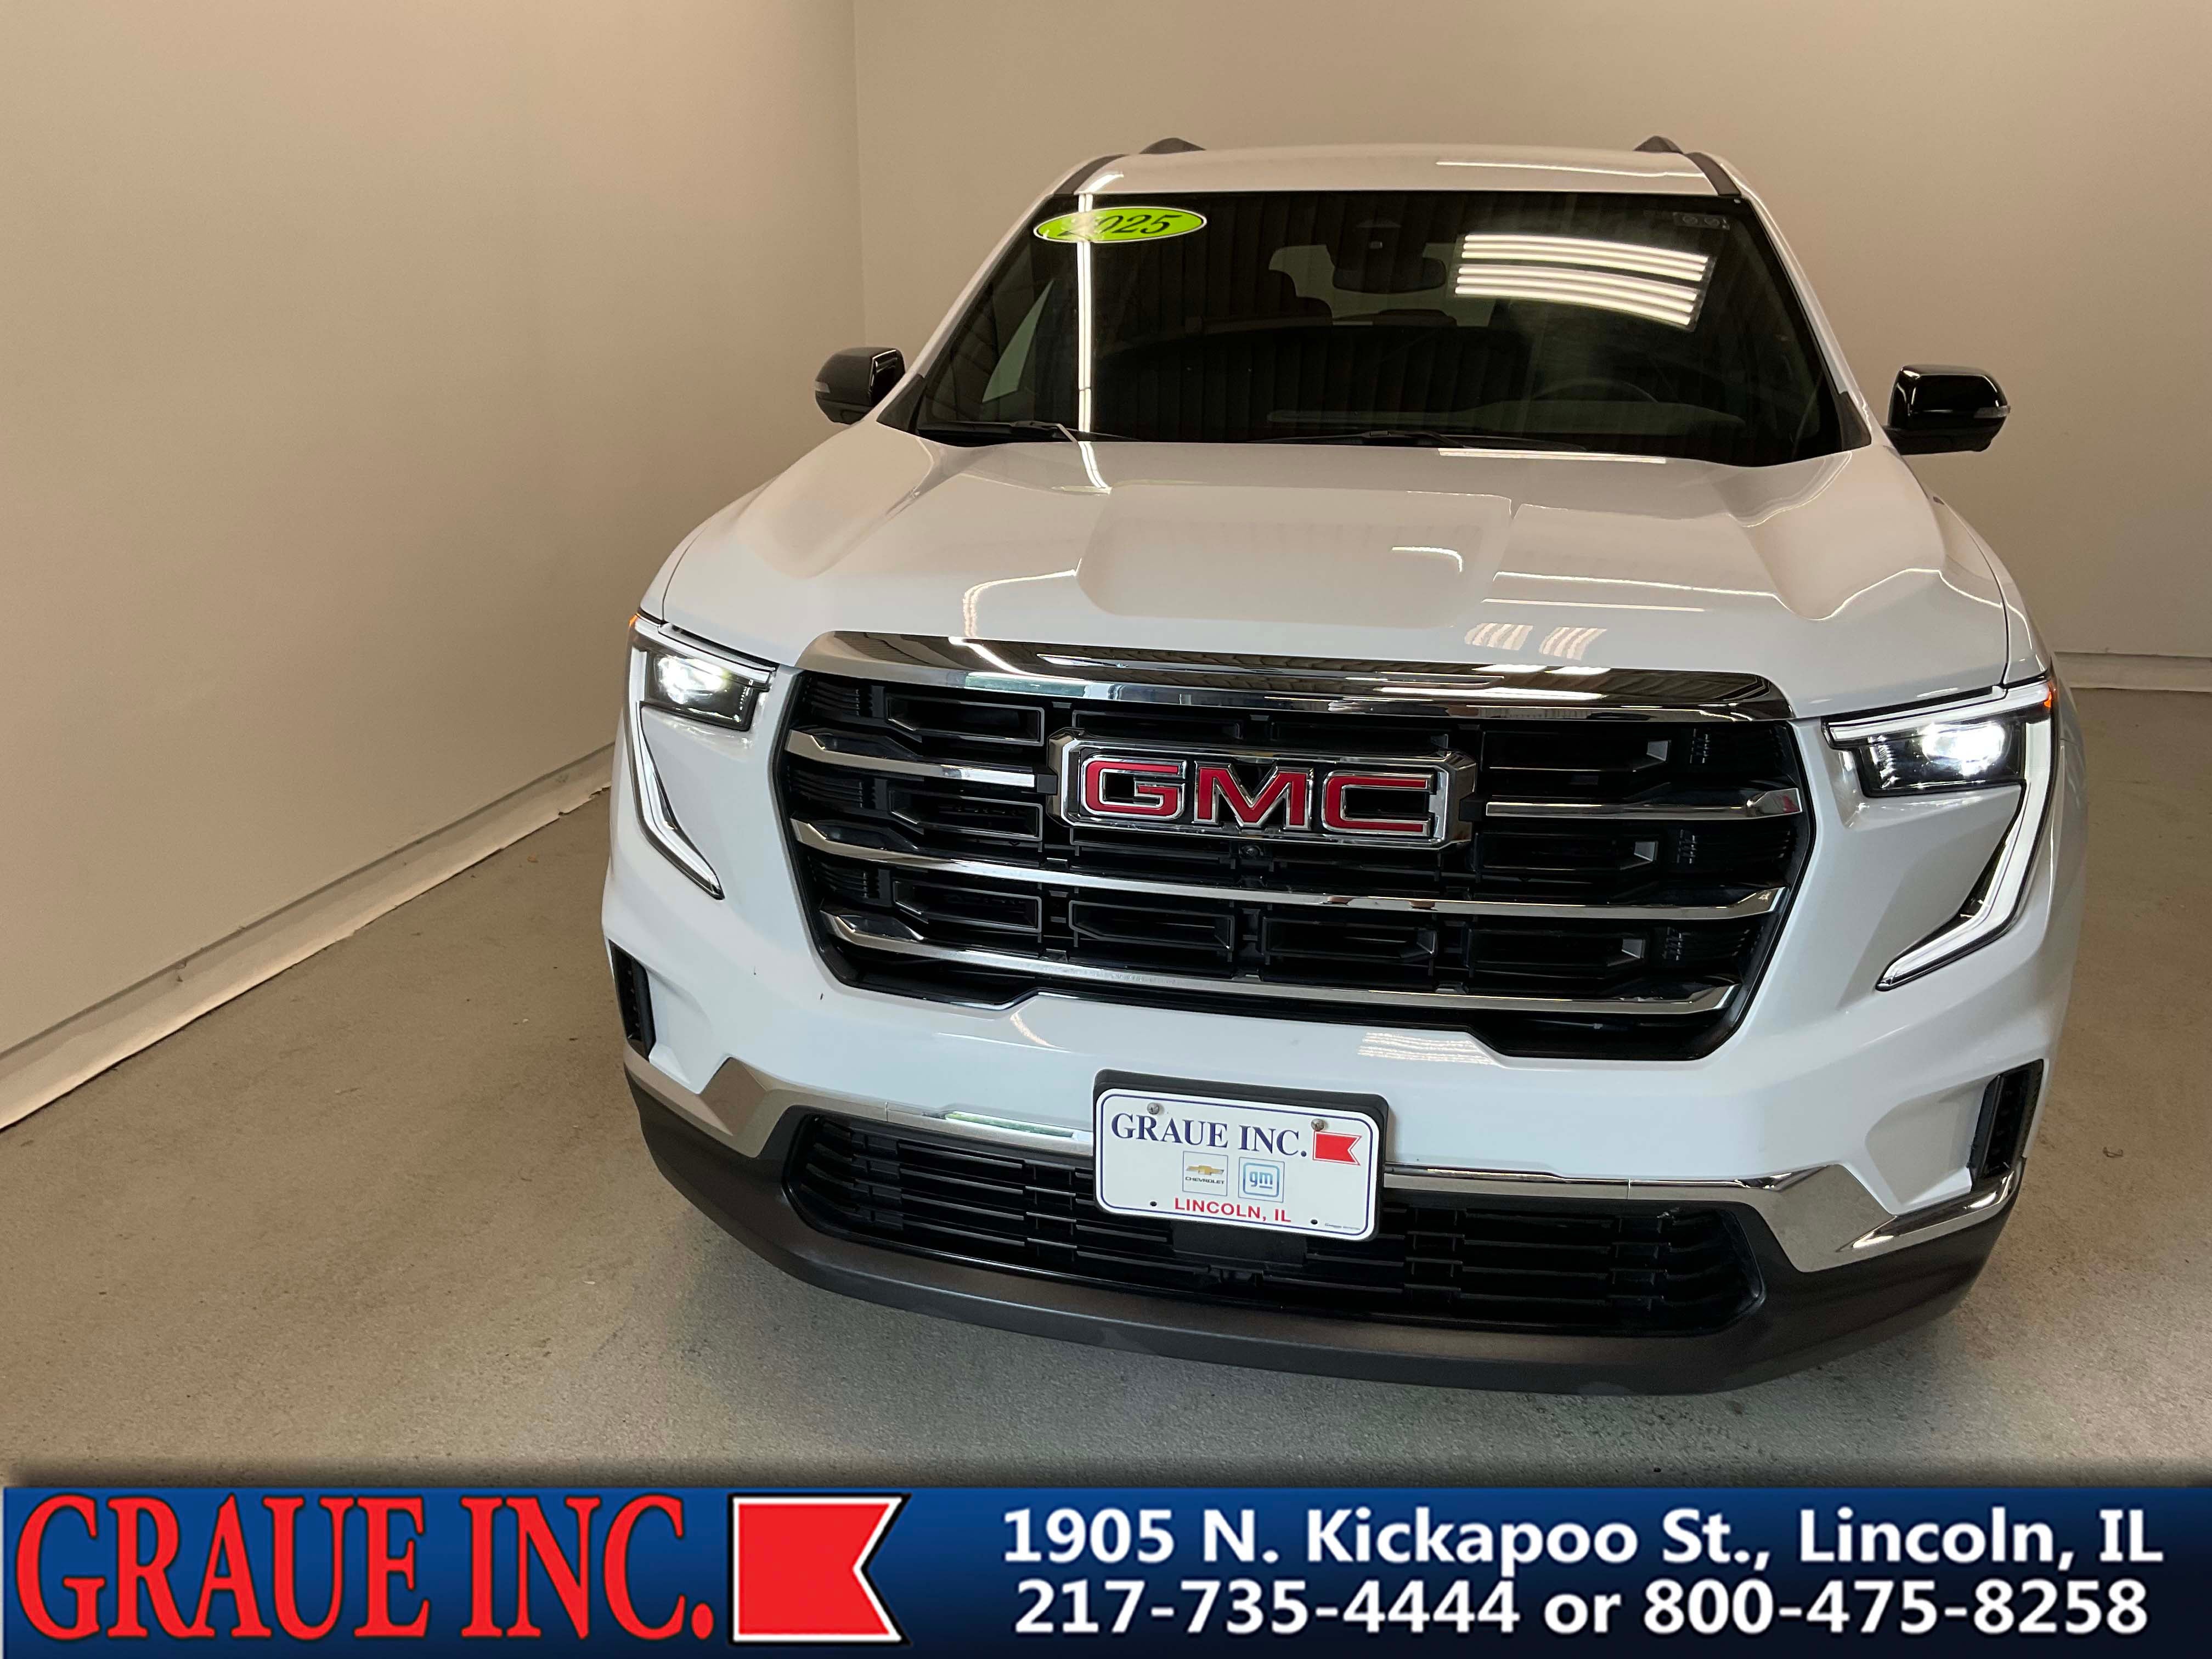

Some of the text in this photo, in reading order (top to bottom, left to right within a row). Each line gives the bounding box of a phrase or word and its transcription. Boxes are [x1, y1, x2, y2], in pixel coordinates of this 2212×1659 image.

[1057, 214, 1183, 237] 025
[1080, 755, 1434, 837] GMC
[1111, 1113, 1307, 1157] GRAUE INC.
[1185, 1176, 1225, 1184] CHEVROLET
[1249, 1171, 1273, 1189] gm
[1175, 1198, 1291, 1222] LINCOLN, IL
